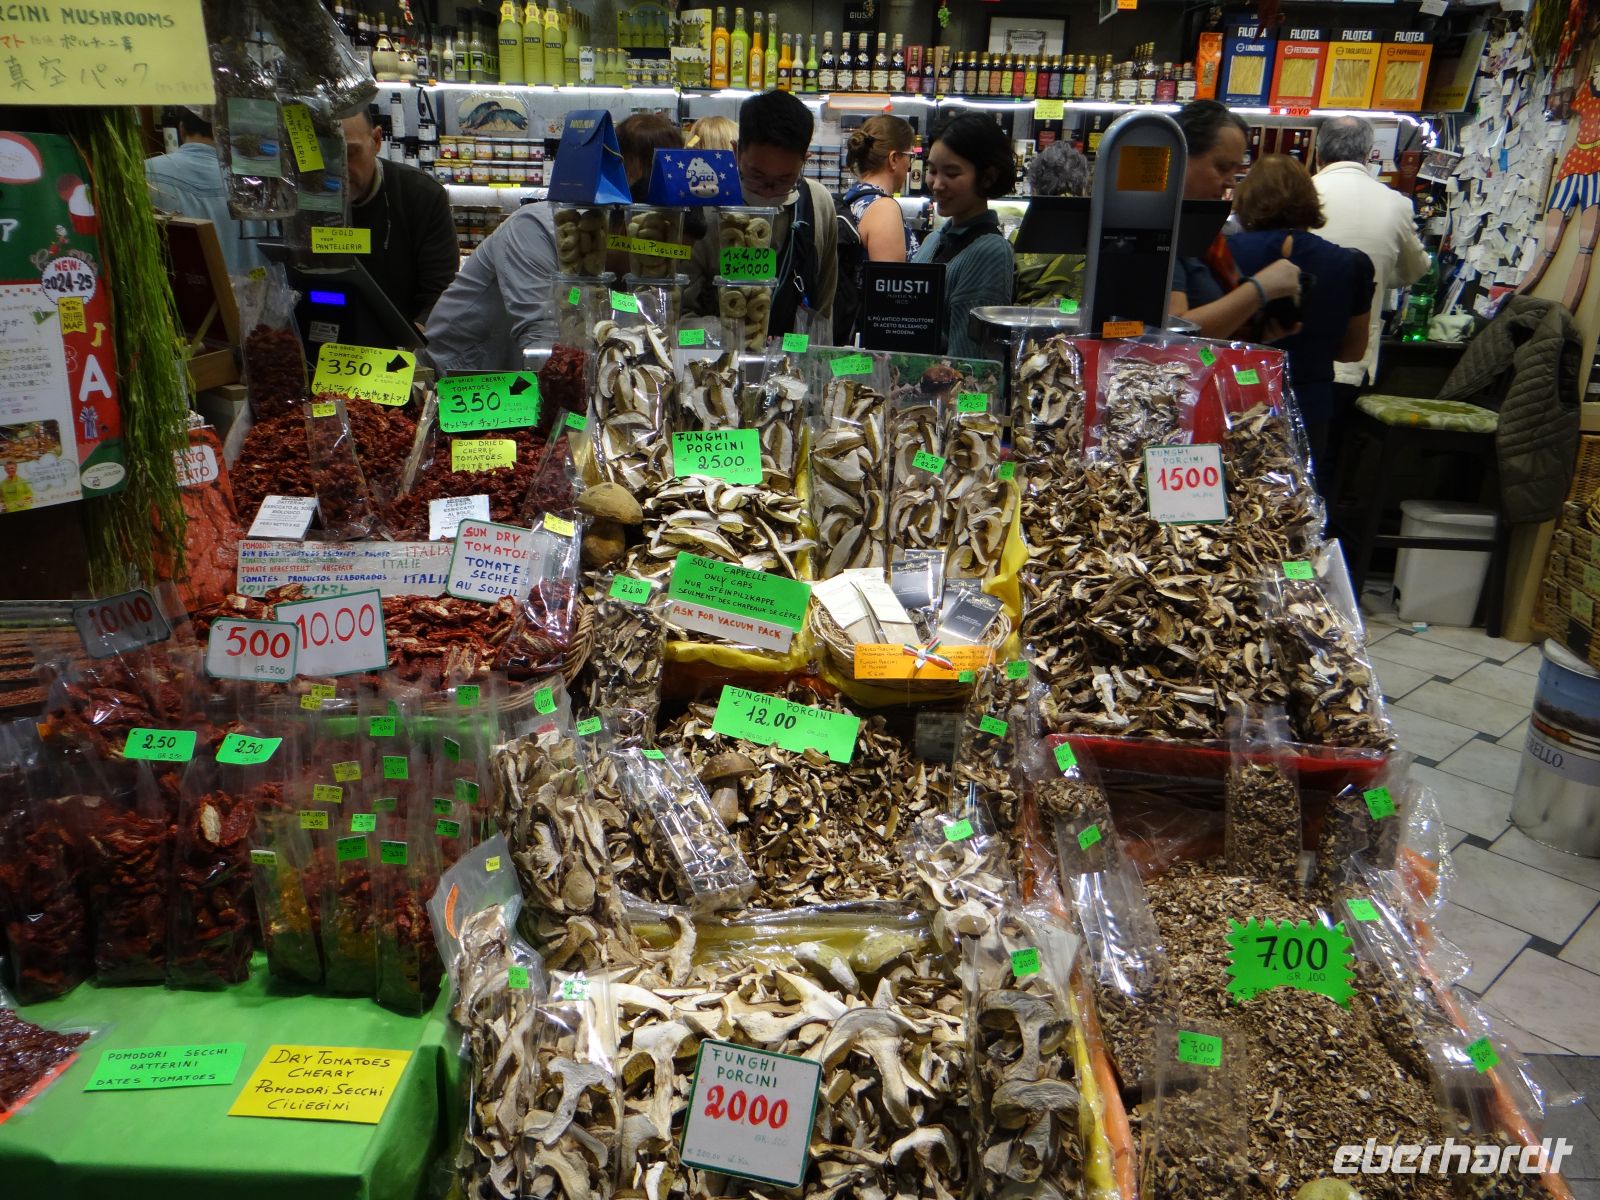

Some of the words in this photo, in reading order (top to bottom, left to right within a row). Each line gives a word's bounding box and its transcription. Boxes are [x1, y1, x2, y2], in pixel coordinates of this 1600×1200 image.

[61, 8, 175, 28] MUSHROOMS
[1238, 27, 1267, 38] FILOTA
[1290, 29, 1320, 41] FILOTEA
[1342, 30, 1372, 41] FILOTEA
[1395, 31, 1424, 43] FILOTEA
[687, 169, 715, 187] Baci
[875, 279, 929, 294] GIUSTI
[79, 354, 112, 402] A
[450, 391, 501, 413] 3.50
[676, 432, 728, 442] FUNGHI
[463, 447, 495, 455] CHERRY
[687, 440, 744, 454] PORCINI
[455, 453, 503, 462] TOMATOES
[463, 526, 488, 538] SUN
[496, 531, 521, 548] DRY
[382, 558, 421, 569] ITALIE
[690, 557, 715, 570] SOLO
[723, 566, 768, 582] CAPPELLE
[242, 575, 279, 583] TOMATES
[287, 575, 331, 583] PRODUCTOS
[335, 574, 387, 583] ELABORADOS
[684, 578, 701, 589] NUR
[704, 573, 727, 587] ONLY
[730, 578, 753, 589] CAPS
[455, 580, 472, 591] AU
[478, 584, 520, 597] SOLEIL
[677, 586, 717, 601] SEULMENT
[732, 601, 767, 613] CHAPEAUX
[296, 603, 375, 649] 10.00
[672, 605, 694, 617] ASK
[697, 610, 714, 620] FOR
[718, 615, 754, 632] VACUUM
[758, 626, 783, 641] PACK
[269, 665, 285, 674] 500
[730, 687, 771, 705] FUNGHI
[786, 701, 832, 721] PORCINI
[746, 705, 797, 730] 12.00
[142, 733, 176, 749] 2.50
[234, 739, 263, 754] 2.50
[1256, 936, 1328, 971] 7.00
[1308, 973, 1326, 982] 100
[108, 1049, 167, 1061] POMODORI
[184, 1047, 228, 1058] SECCHI
[269, 1049, 314, 1065] DRY
[318, 1050, 391, 1068] TOMATOES
[711, 1047, 777, 1073] FUNGHI
[130, 1061, 198, 1072] DATTERINI
[288, 1067, 355, 1079] CHERRY
[95, 1077, 141, 1087] DATES
[151, 1073, 216, 1084] TOMATOES
[717, 1066, 777, 1088] PORCINI
